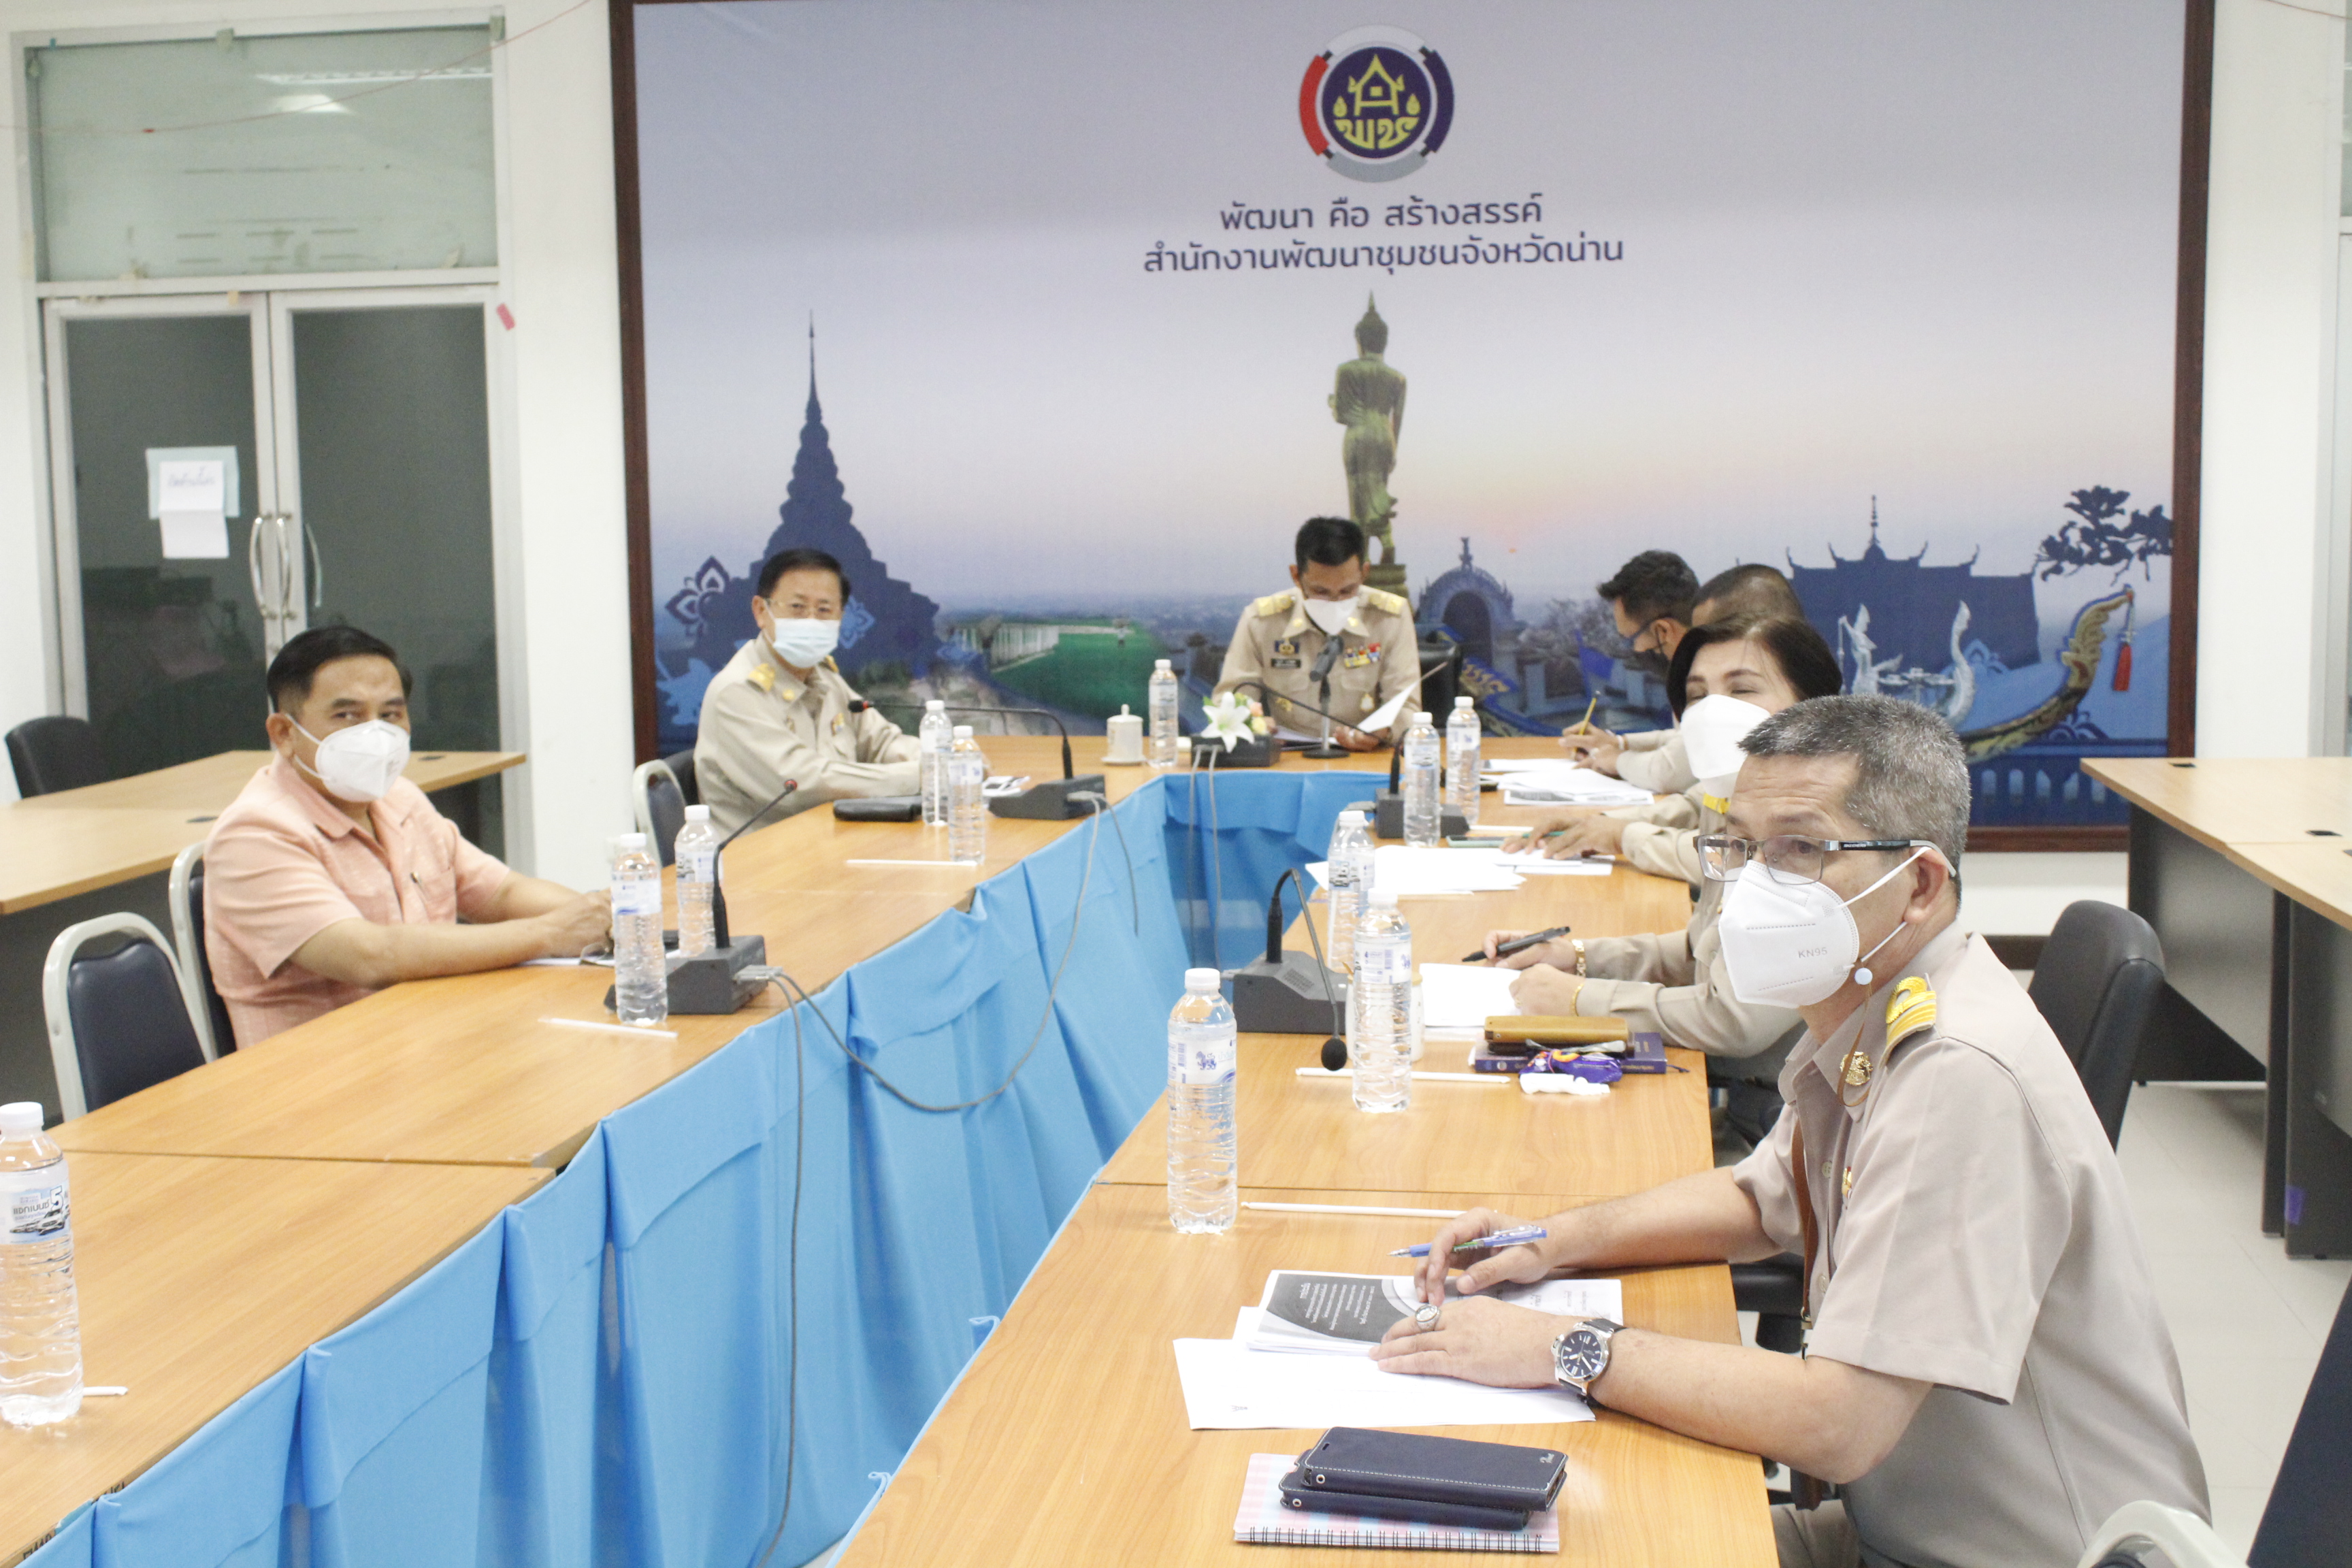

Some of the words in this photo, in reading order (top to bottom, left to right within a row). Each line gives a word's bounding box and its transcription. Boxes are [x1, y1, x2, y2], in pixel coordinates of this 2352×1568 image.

[1220, 201, 1313, 231] พัฒนา
[1329, 197, 1370, 228] คือ
[1384, 192, 1543, 227] สร้างสรรค์
[1143, 231, 1624, 276] สำนักงานพัฒนาชุมชนจังหวัดน่าน
[1798, 947, 1827, 959] KN95
